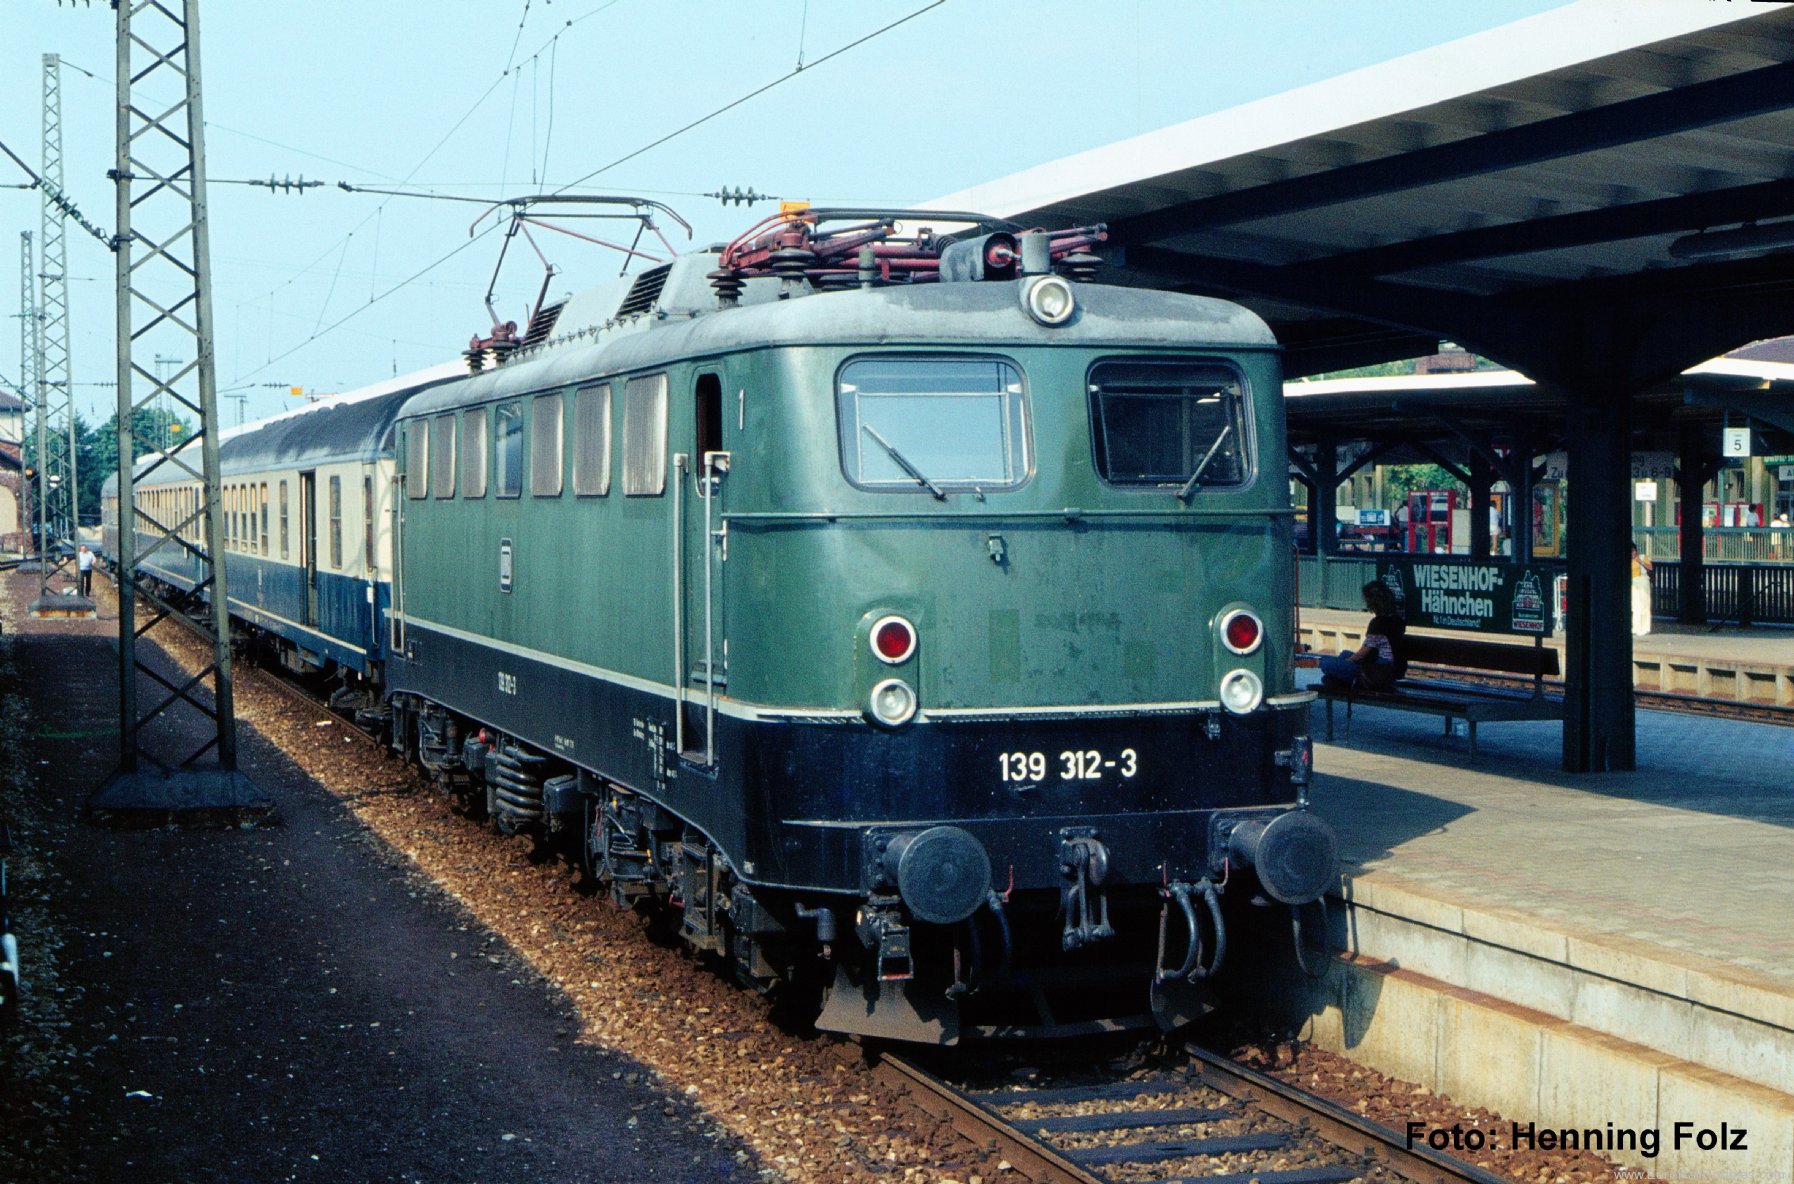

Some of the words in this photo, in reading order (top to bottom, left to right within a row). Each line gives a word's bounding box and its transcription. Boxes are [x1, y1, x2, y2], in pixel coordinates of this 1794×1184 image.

[1733, 439, 1742, 451] 5
[1413, 564, 1504, 592] WIESENHOF-
[1421, 589, 1493, 618] Hähnchen
[998, 751, 1047, 782] 139
[1059, 748, 1138, 780] 312-3
